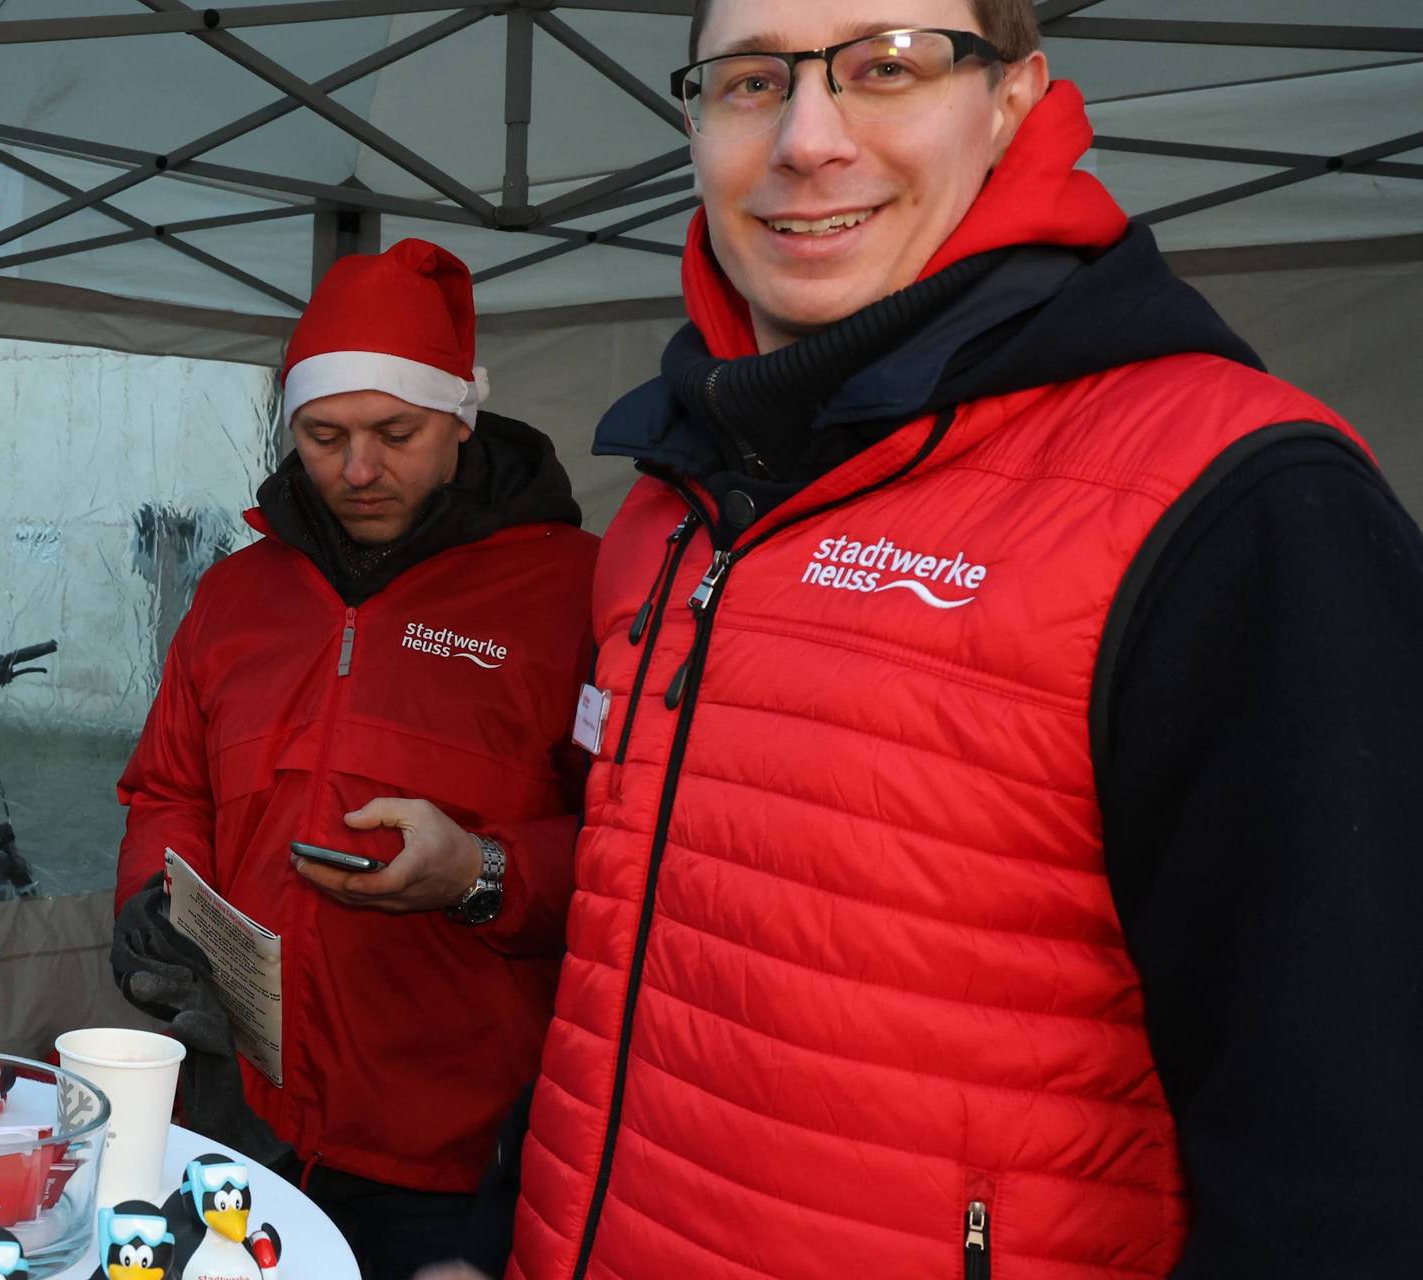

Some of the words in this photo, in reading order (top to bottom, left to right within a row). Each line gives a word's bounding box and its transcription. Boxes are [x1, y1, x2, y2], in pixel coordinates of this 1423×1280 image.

[801, 561, 881, 592] neuss
[813, 535, 987, 589] stadtwerke
[401, 635, 451, 658] neuss
[405, 622, 507, 660] stadtwerke
